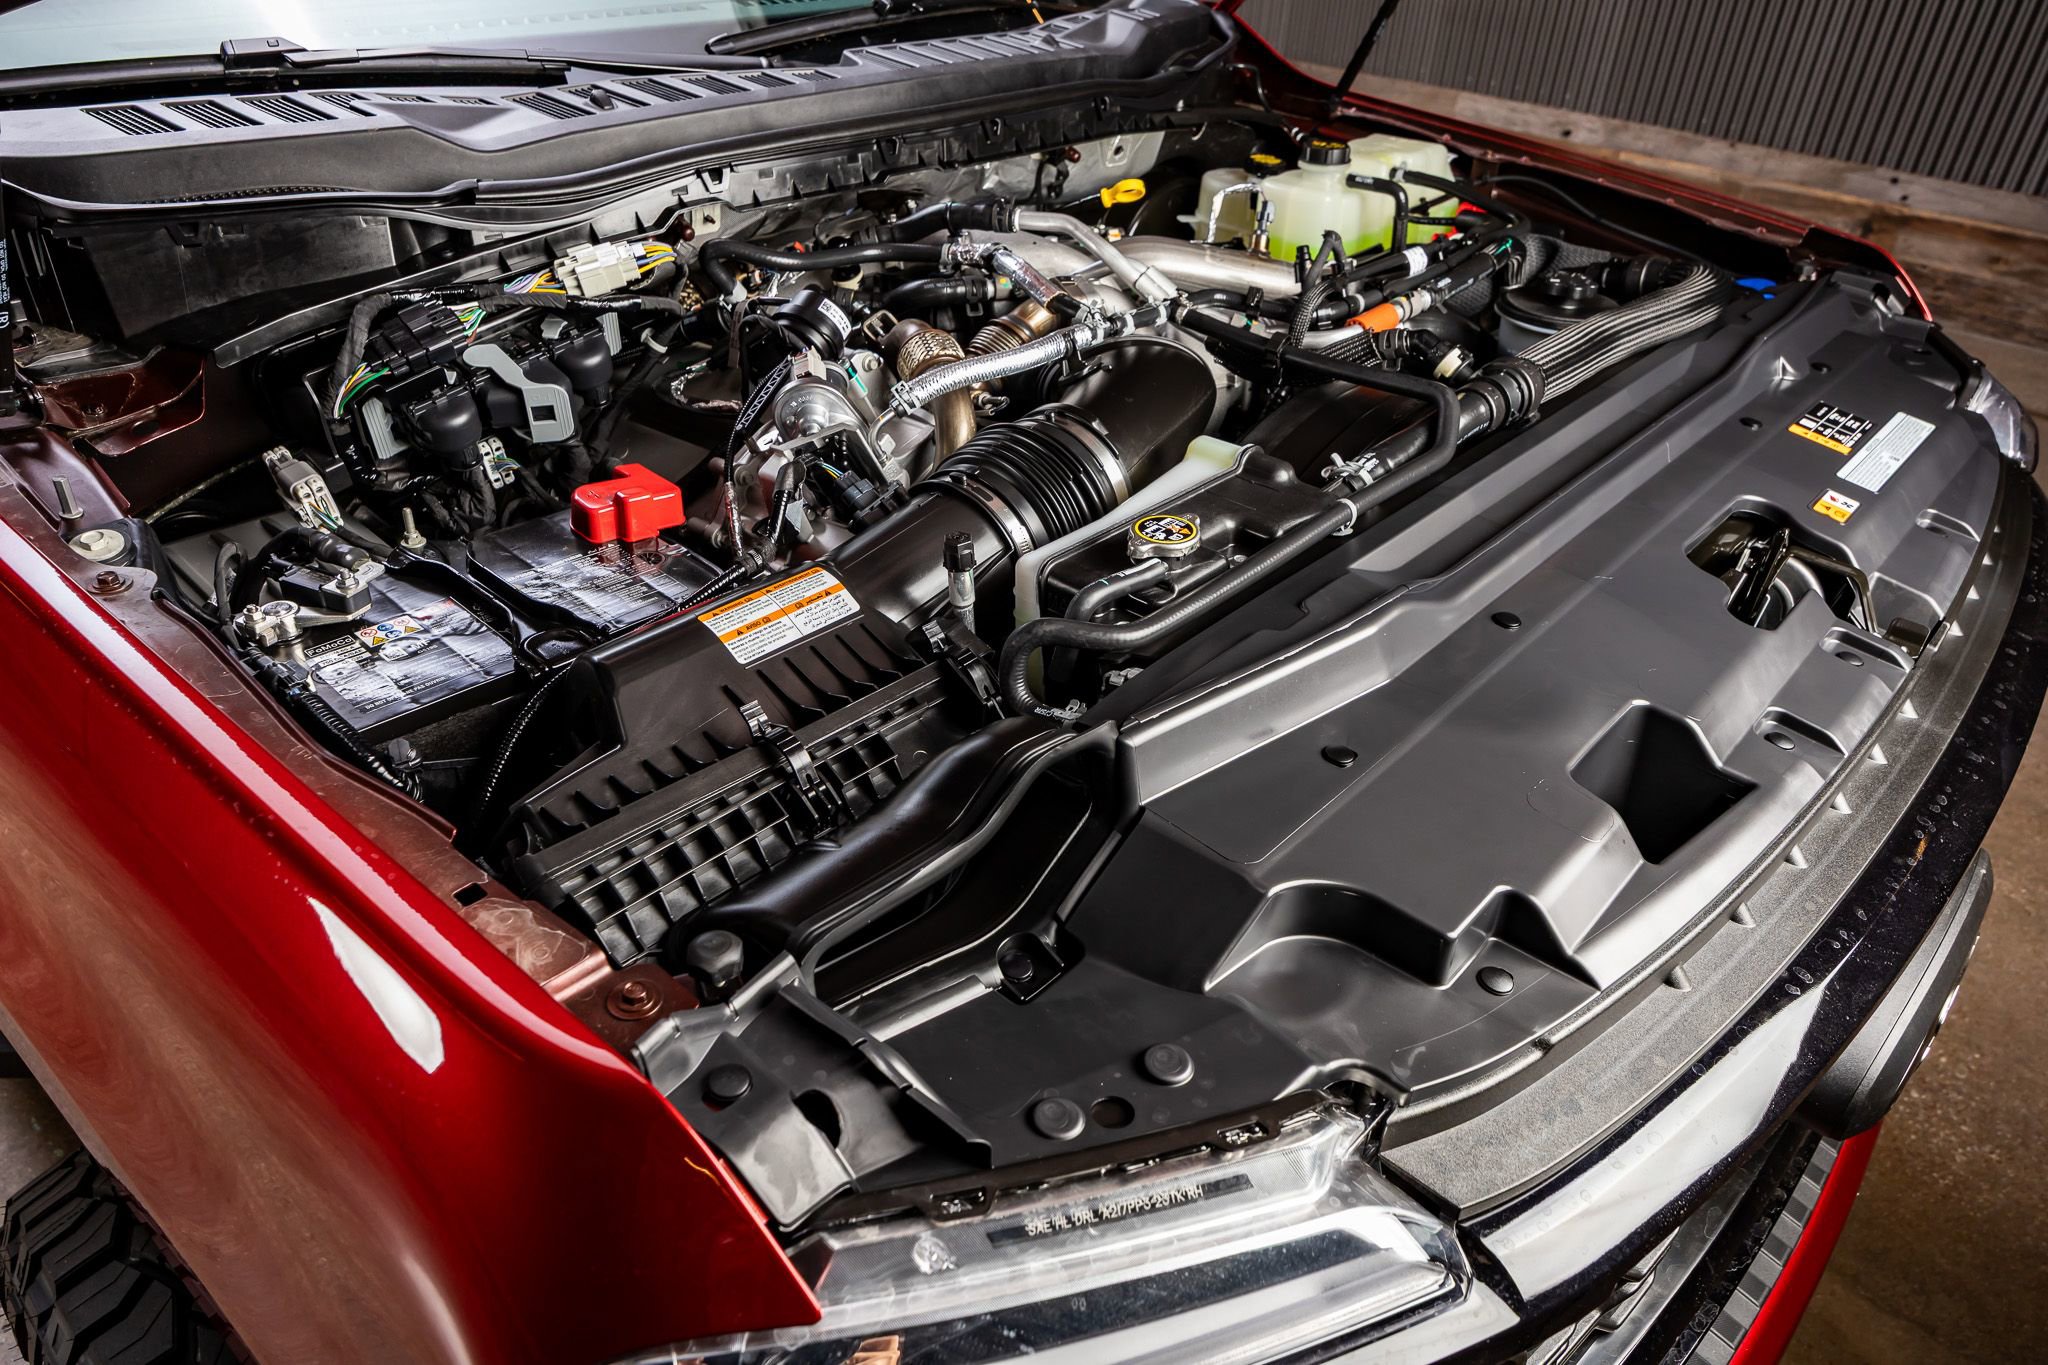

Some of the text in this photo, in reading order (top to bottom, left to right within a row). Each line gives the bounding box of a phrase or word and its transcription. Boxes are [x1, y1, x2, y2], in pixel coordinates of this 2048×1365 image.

[745, 621, 761, 630] AVISO
[308, 638, 352, 656] FoMoCo
[1026, 1217, 1052, 1236] SAE
[1054, 1213, 1072, 1230] HL
[1073, 1207, 1099, 1226] DRL
[1186, 1184, 1203, 1199] RH
